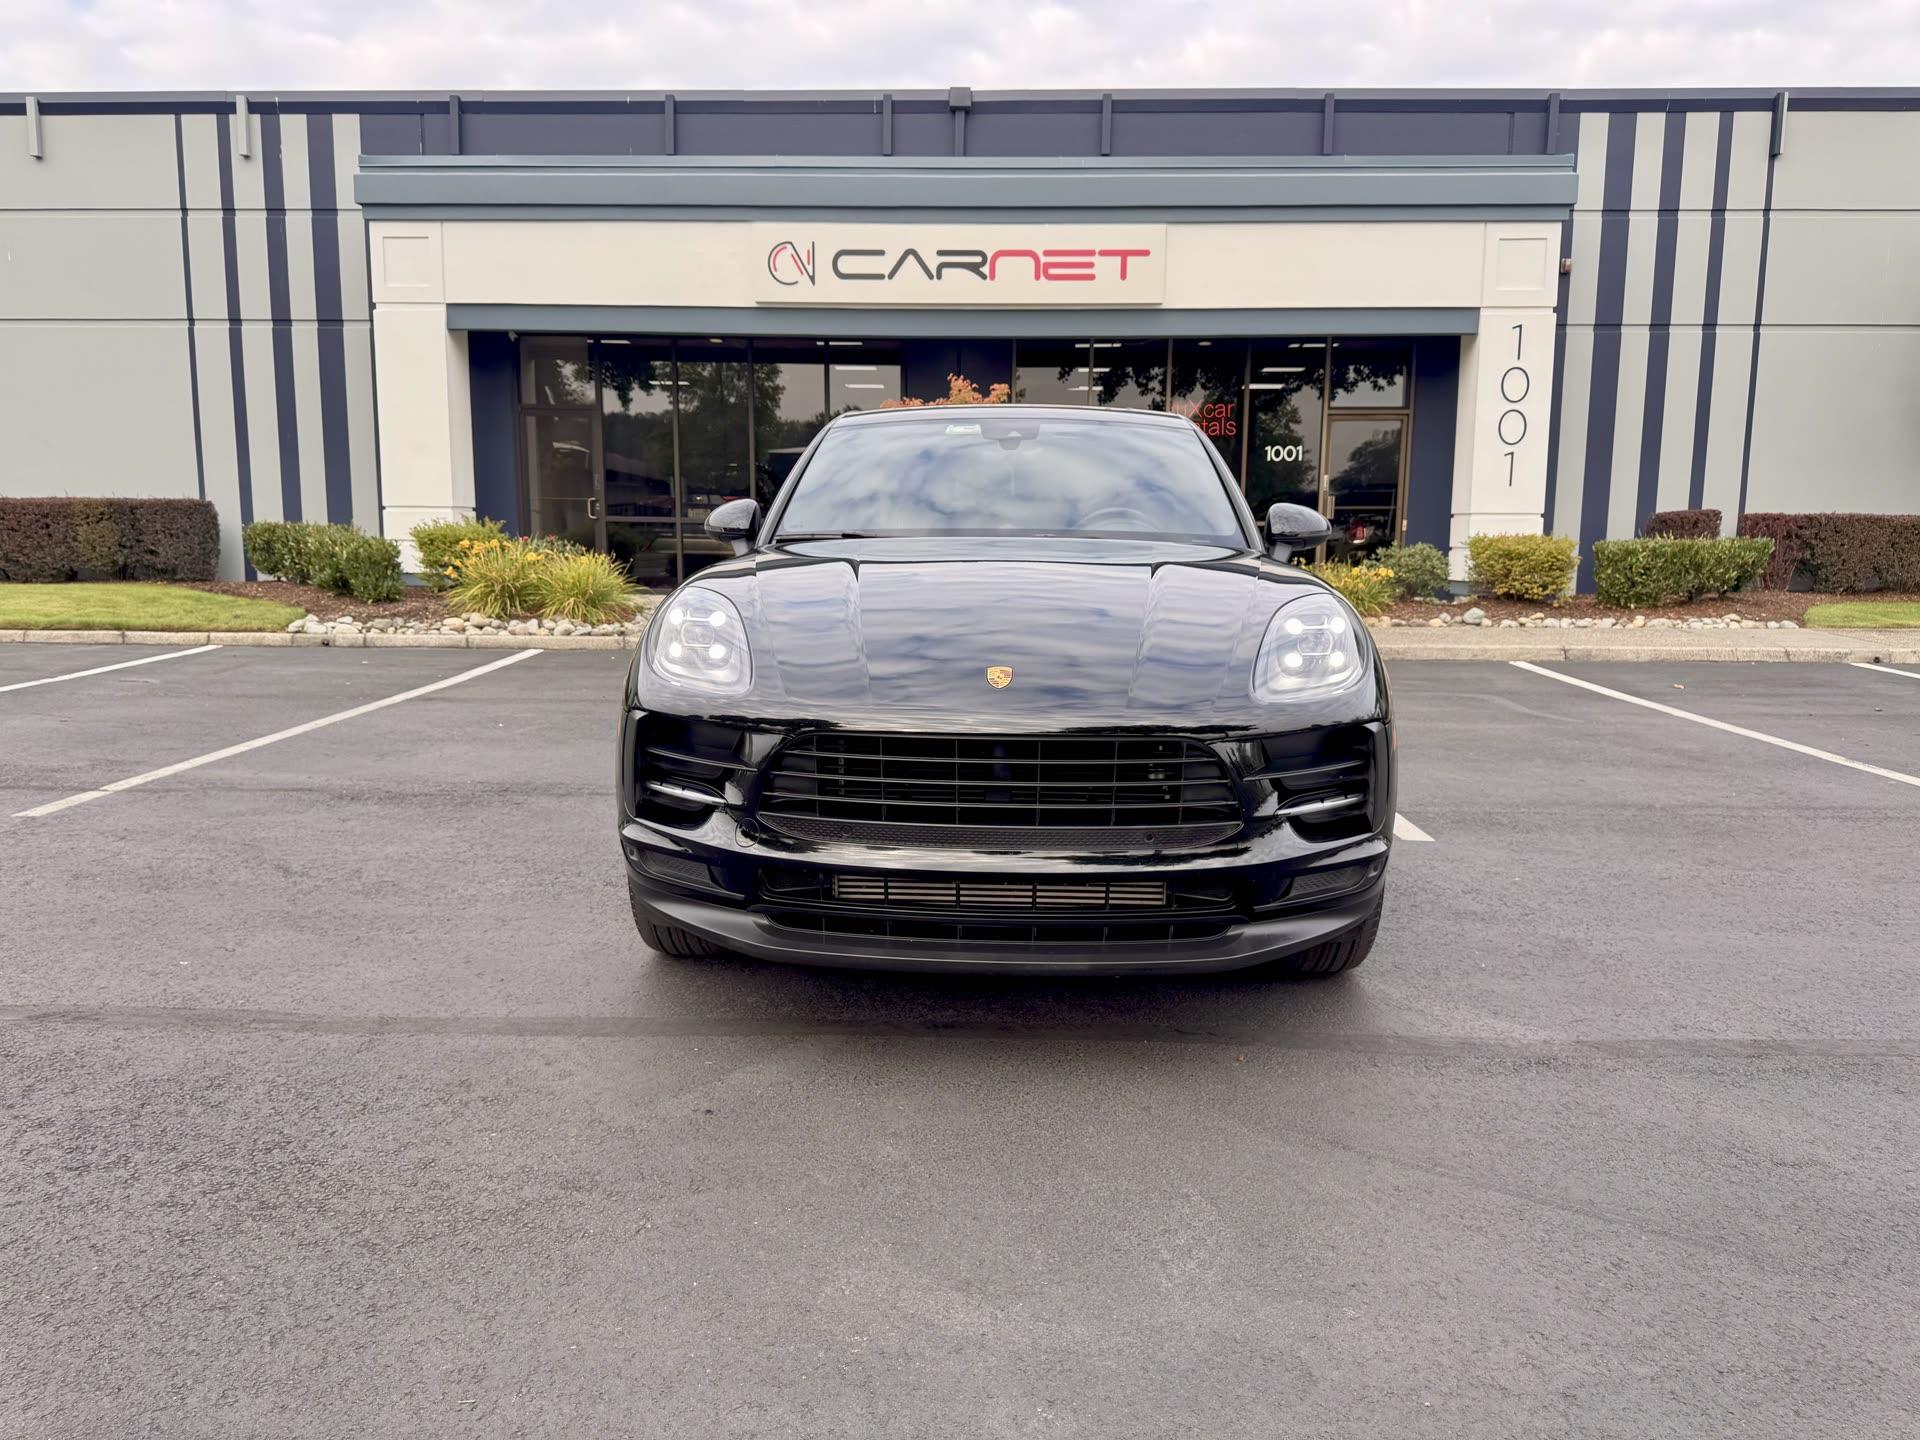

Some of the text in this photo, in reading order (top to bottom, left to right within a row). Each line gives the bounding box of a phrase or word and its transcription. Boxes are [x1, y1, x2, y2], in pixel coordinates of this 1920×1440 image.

[832, 248, 1151, 281] CARNET
[1498, 324, 1530, 487] 1001
[1264, 445, 1303, 462] 1001
